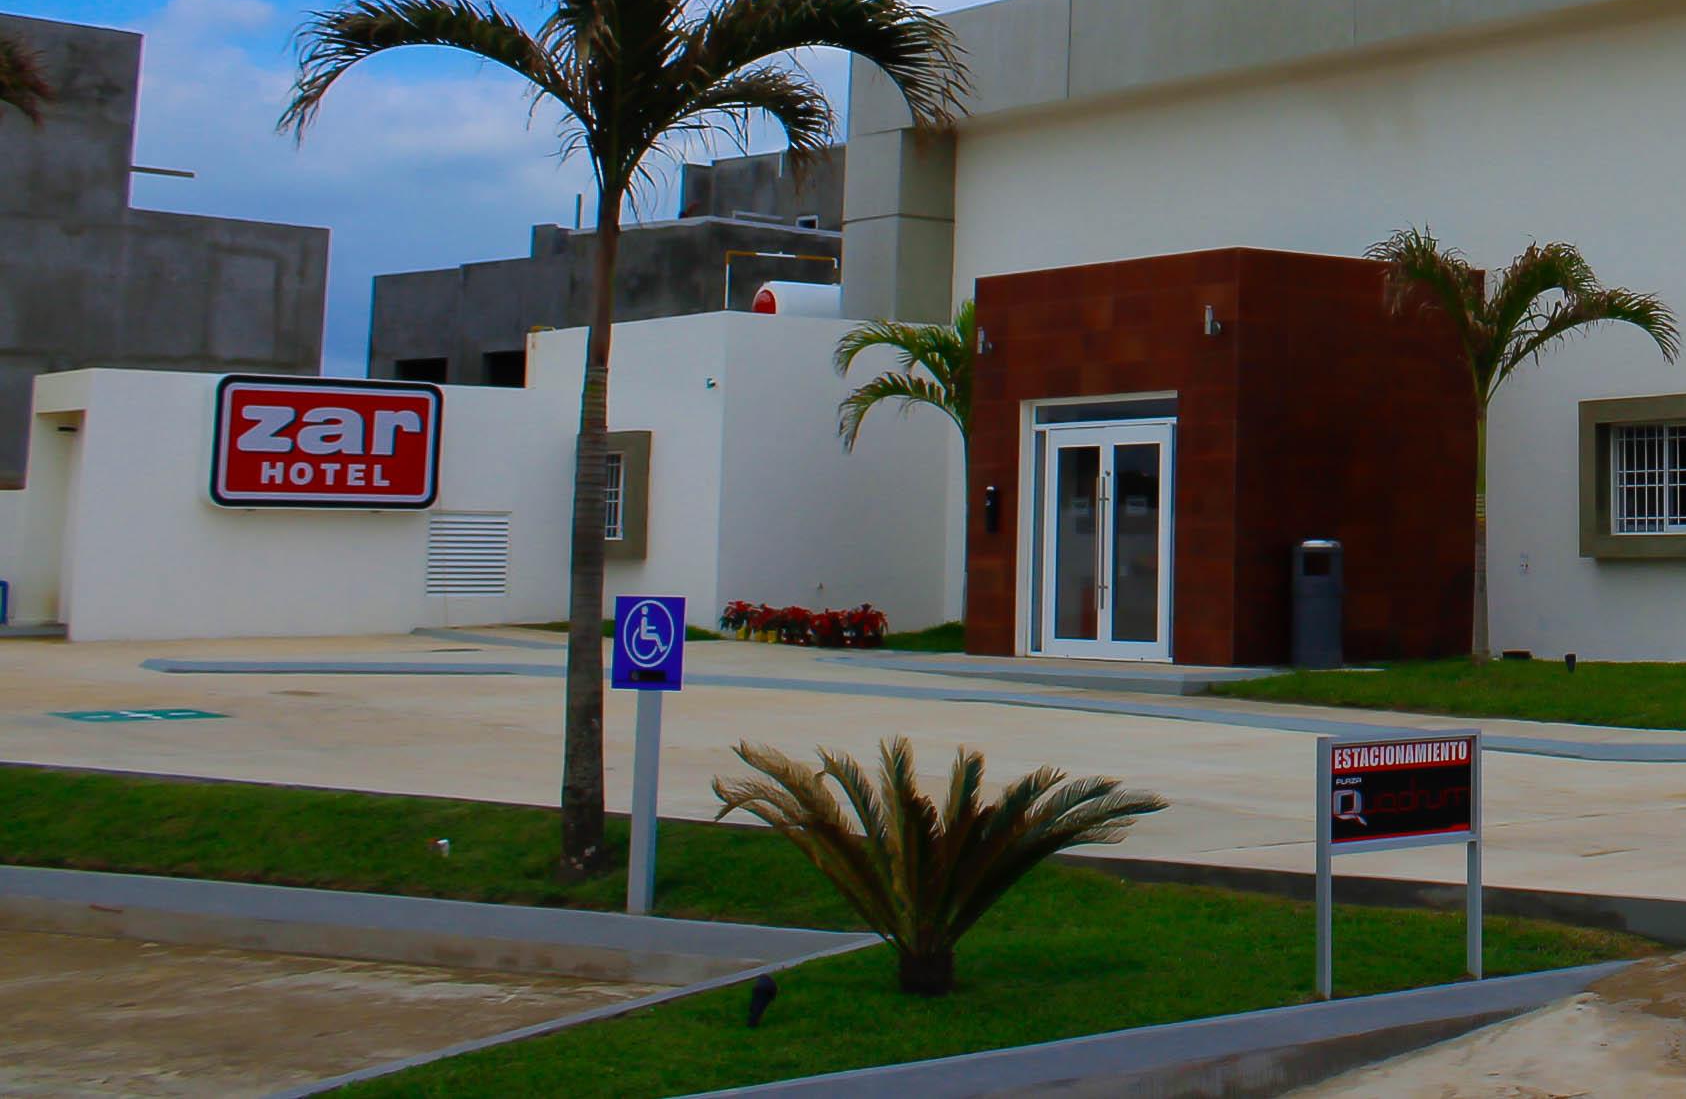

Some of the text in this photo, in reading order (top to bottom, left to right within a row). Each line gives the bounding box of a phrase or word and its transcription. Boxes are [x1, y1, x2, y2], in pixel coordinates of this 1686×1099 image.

[236, 405, 422, 456] zar
[260, 461, 391, 487] HOTEL
[1334, 740, 1468, 769] ESTACIONAMIENTO
[1335, 777, 1362, 786] PLAZA
